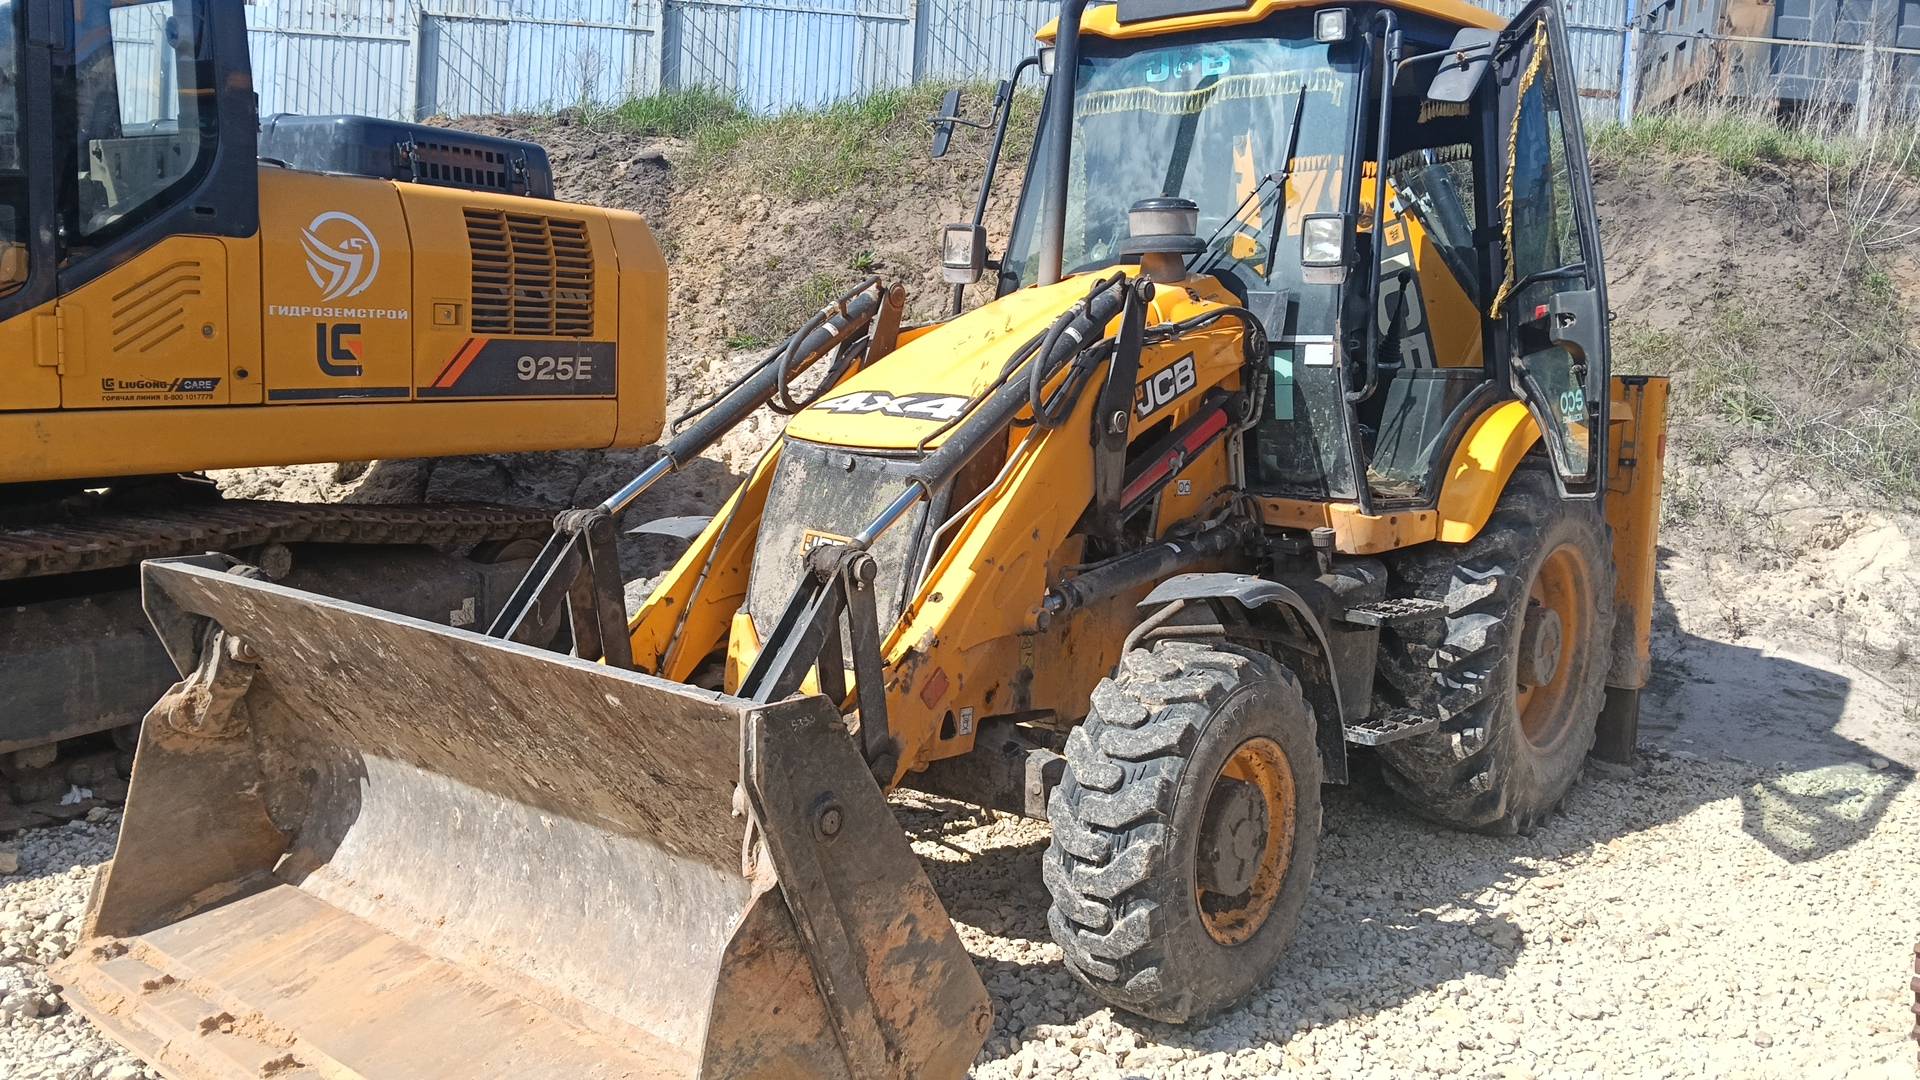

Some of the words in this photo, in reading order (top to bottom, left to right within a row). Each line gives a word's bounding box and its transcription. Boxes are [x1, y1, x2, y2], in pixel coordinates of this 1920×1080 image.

[269, 304, 408, 320] ГИДРОЗЕМСТРОЙ
[517, 355, 592, 380] 925E
[184, 380, 212, 389] CARE
[1137, 356, 1195, 416] JCB
[811, 392, 968, 419] 4X4
